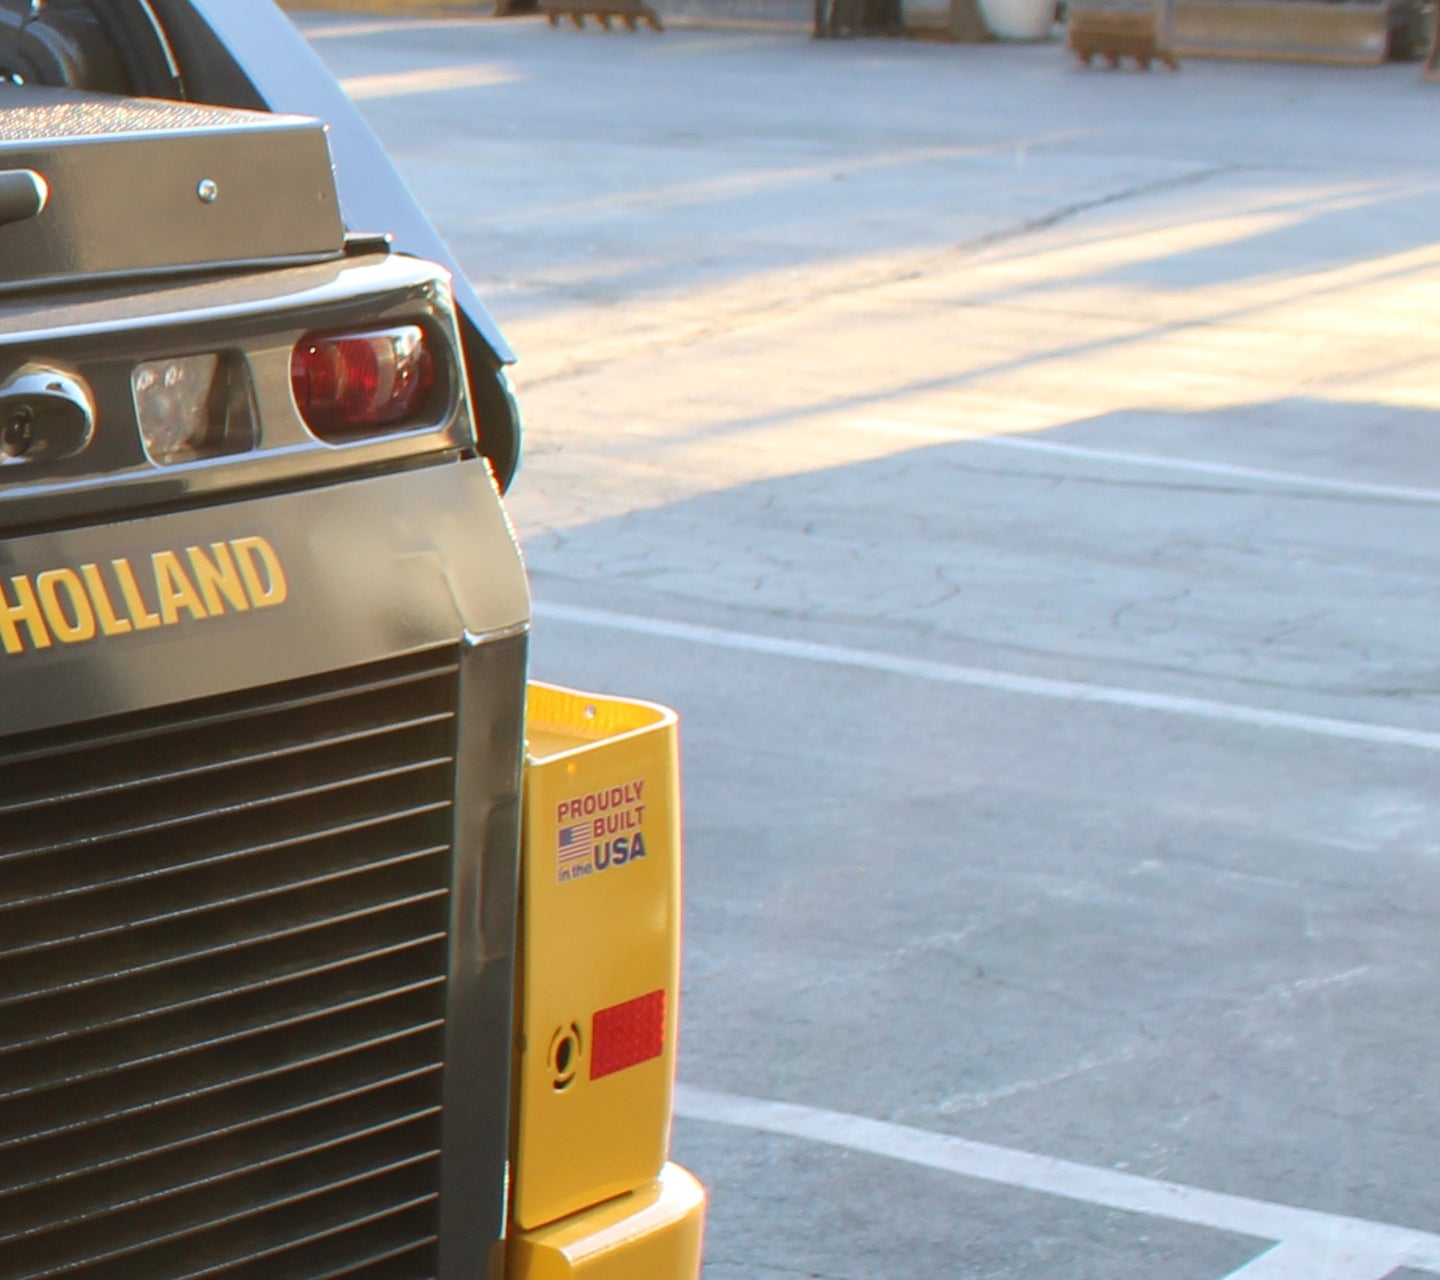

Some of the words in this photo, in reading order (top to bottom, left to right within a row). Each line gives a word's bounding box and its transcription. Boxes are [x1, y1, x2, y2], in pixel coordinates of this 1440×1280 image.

[556, 779, 644, 824] PROUDLY
[592, 805, 646, 839] BUILT
[558, 867, 571, 883] in
[571, 862, 594, 879] the
[592, 831, 647, 871] USA
